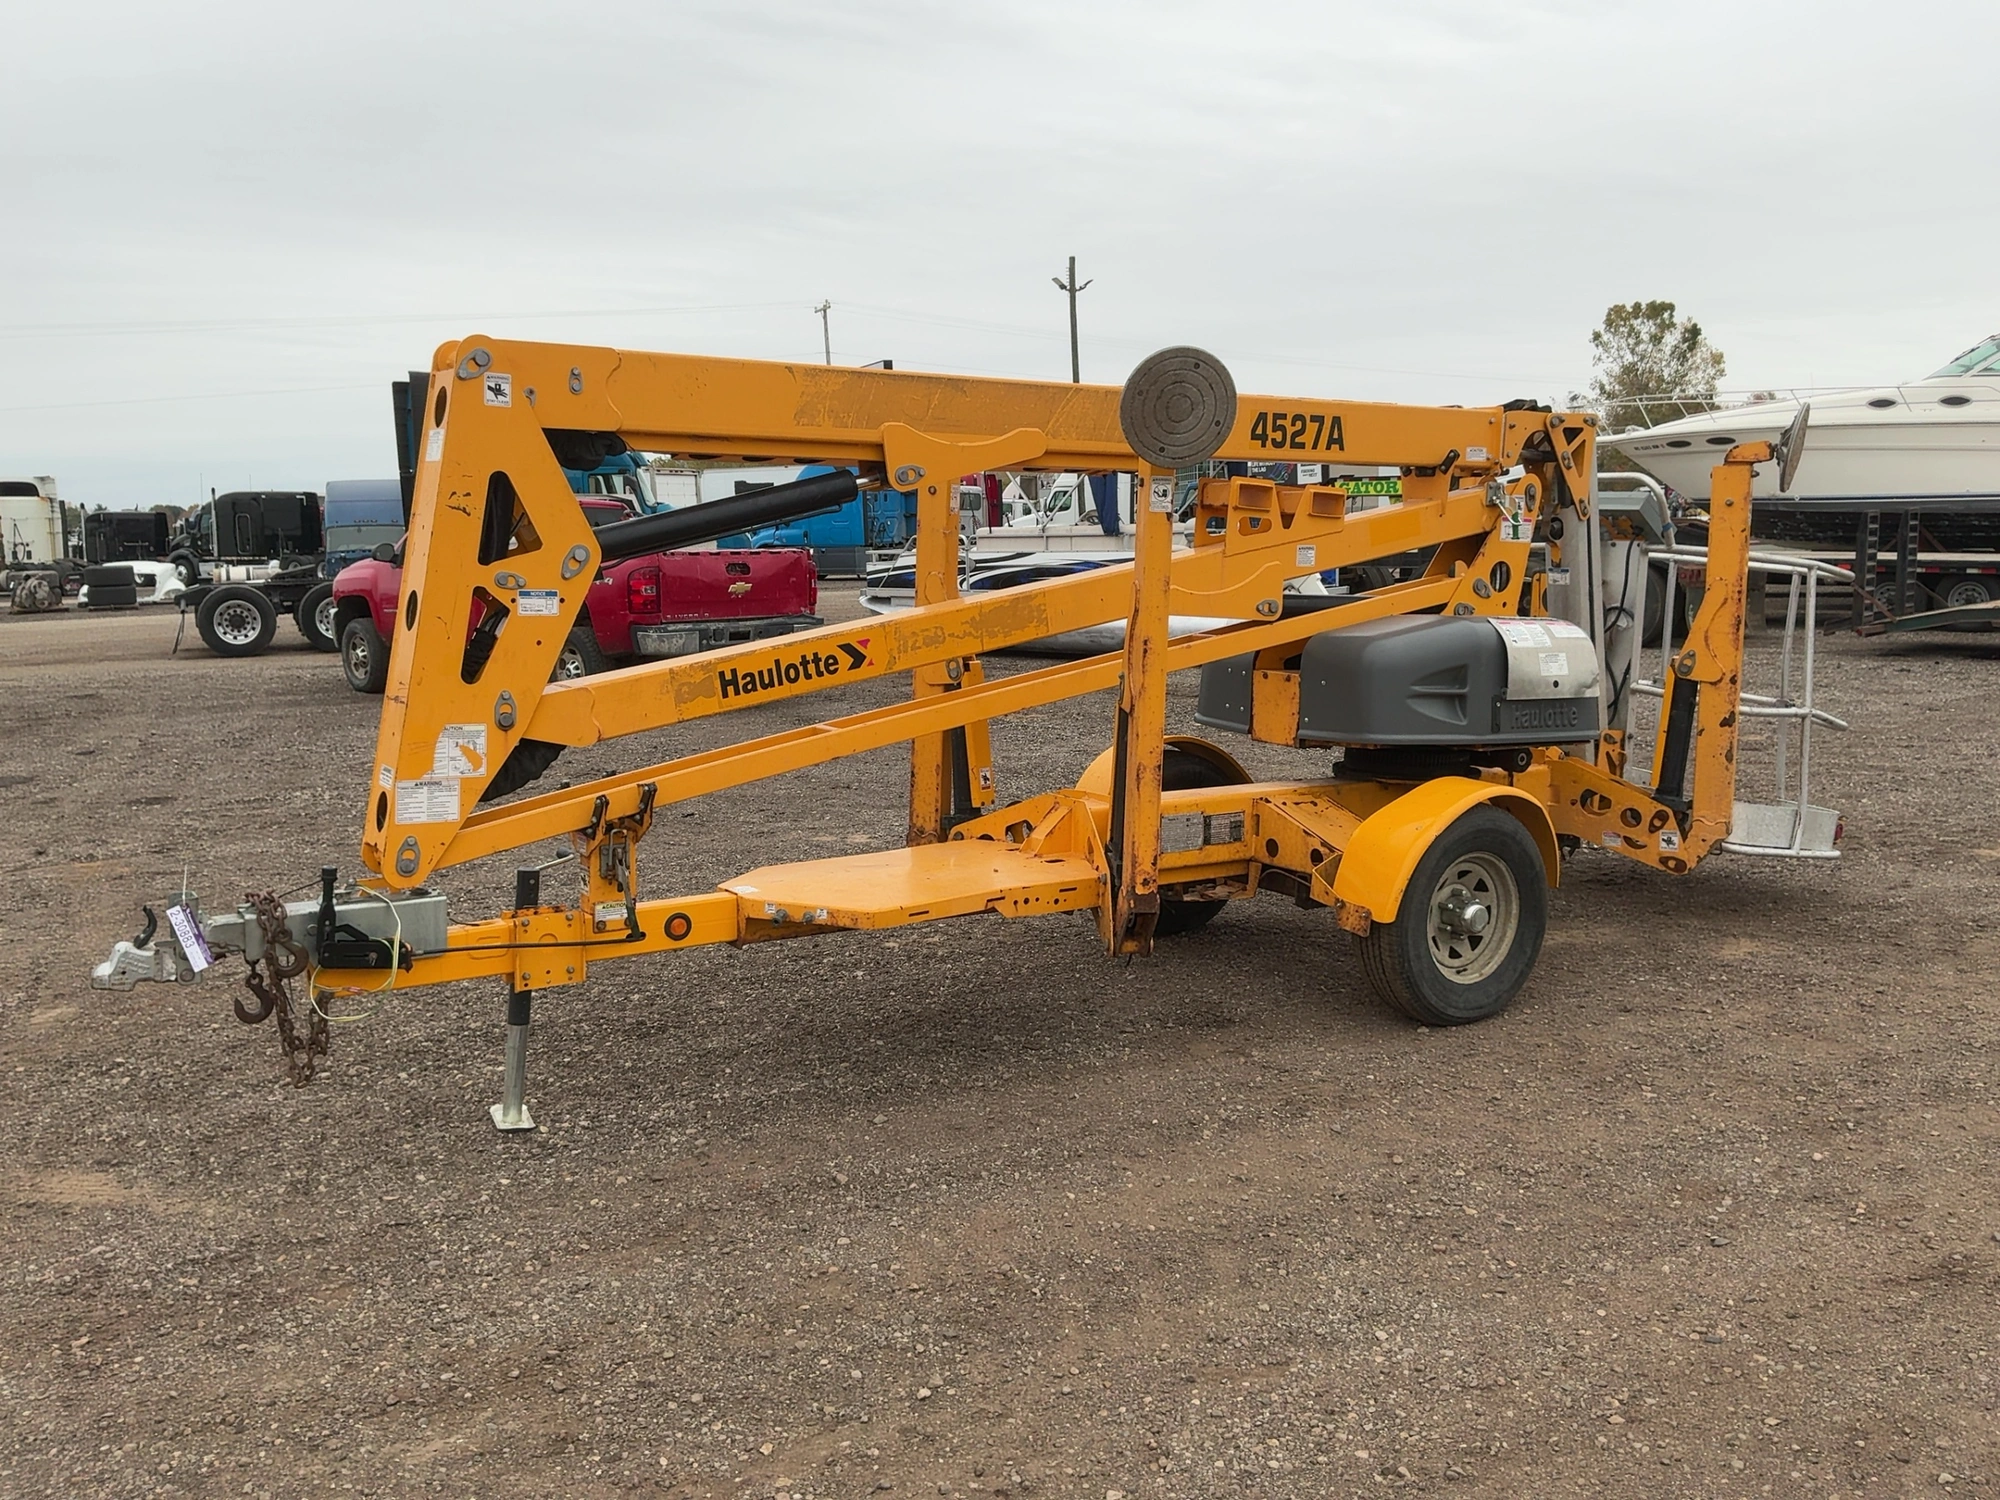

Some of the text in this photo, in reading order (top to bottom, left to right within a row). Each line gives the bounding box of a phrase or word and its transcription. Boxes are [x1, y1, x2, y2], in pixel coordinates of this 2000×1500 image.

[1250, 412, 1345, 451] 4527A
[1339, 481, 1400, 495] GATOR
[718, 652, 840, 699] Haulotte
[1511, 702, 1579, 730] Haulotte
[169, 909, 196, 949] 2-30883
